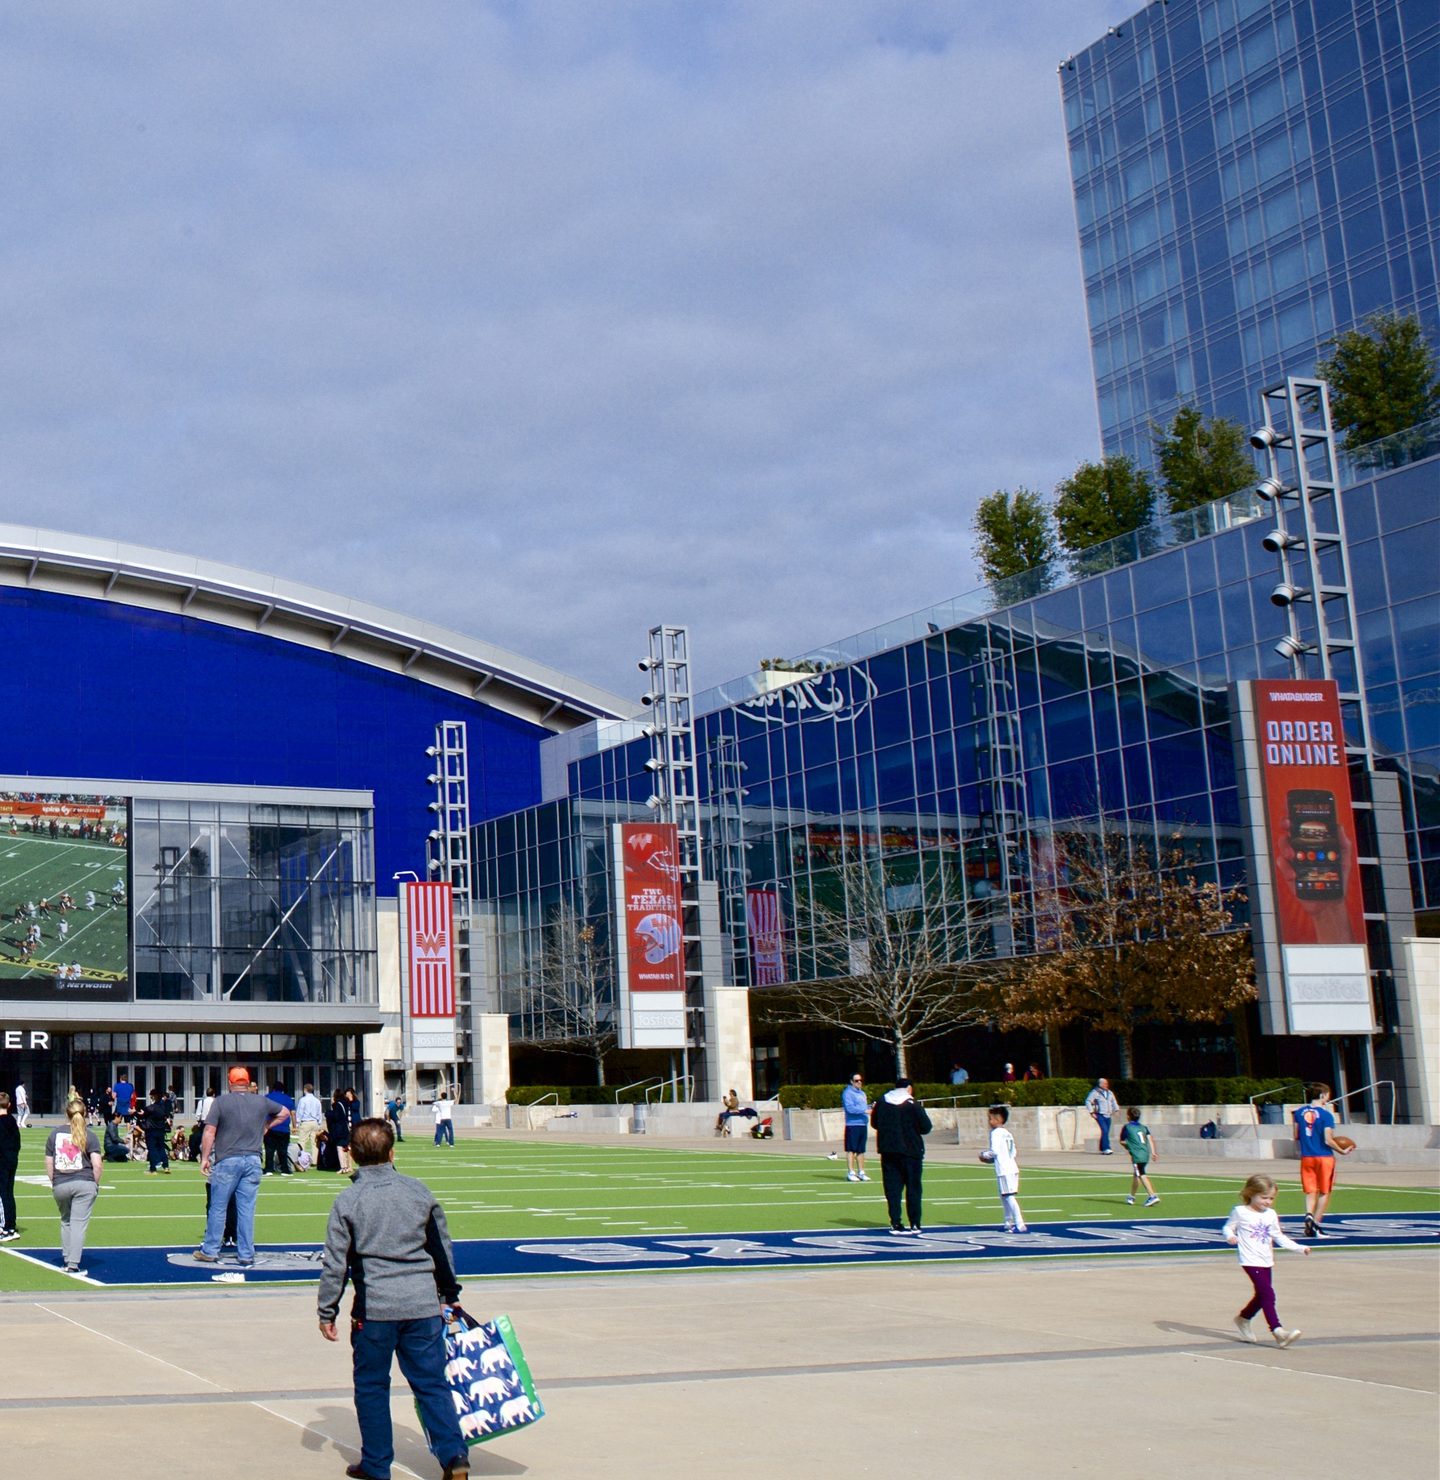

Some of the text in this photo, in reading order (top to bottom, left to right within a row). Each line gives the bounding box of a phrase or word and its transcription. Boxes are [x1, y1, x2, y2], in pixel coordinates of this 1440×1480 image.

[1266, 720, 1334, 742] ORDER
[1266, 743, 1340, 765] ONLINE
[631, 894, 674, 905] TEXAS
[1137, 1131, 1146, 1144] 1
